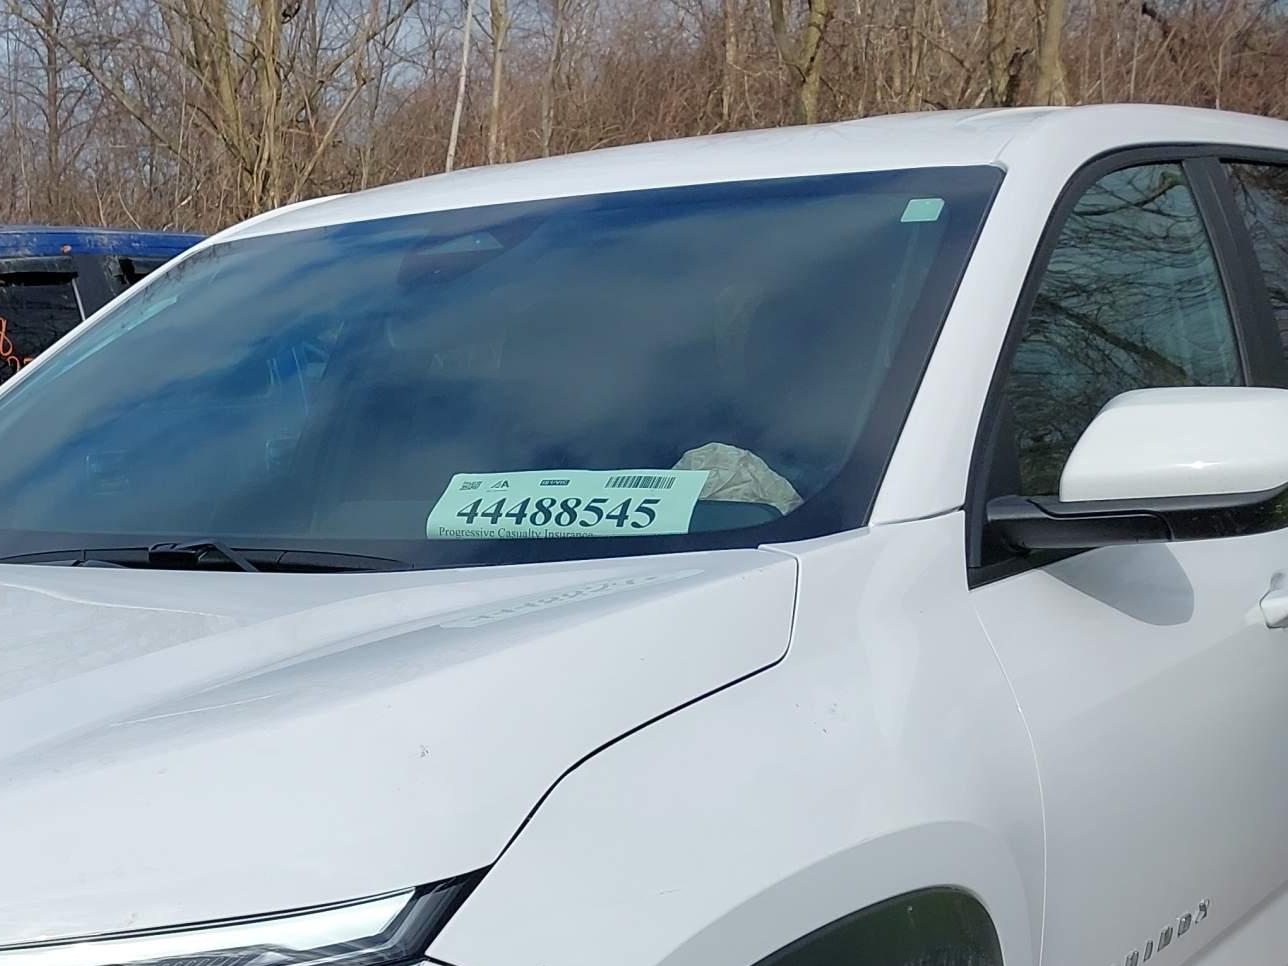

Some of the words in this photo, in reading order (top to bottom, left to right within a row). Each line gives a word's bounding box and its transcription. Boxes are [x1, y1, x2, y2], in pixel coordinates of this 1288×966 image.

[456, 496, 662, 529] 44488545
[439, 526, 495, 538] Progressive
[497, 527, 541, 538] Casualty
